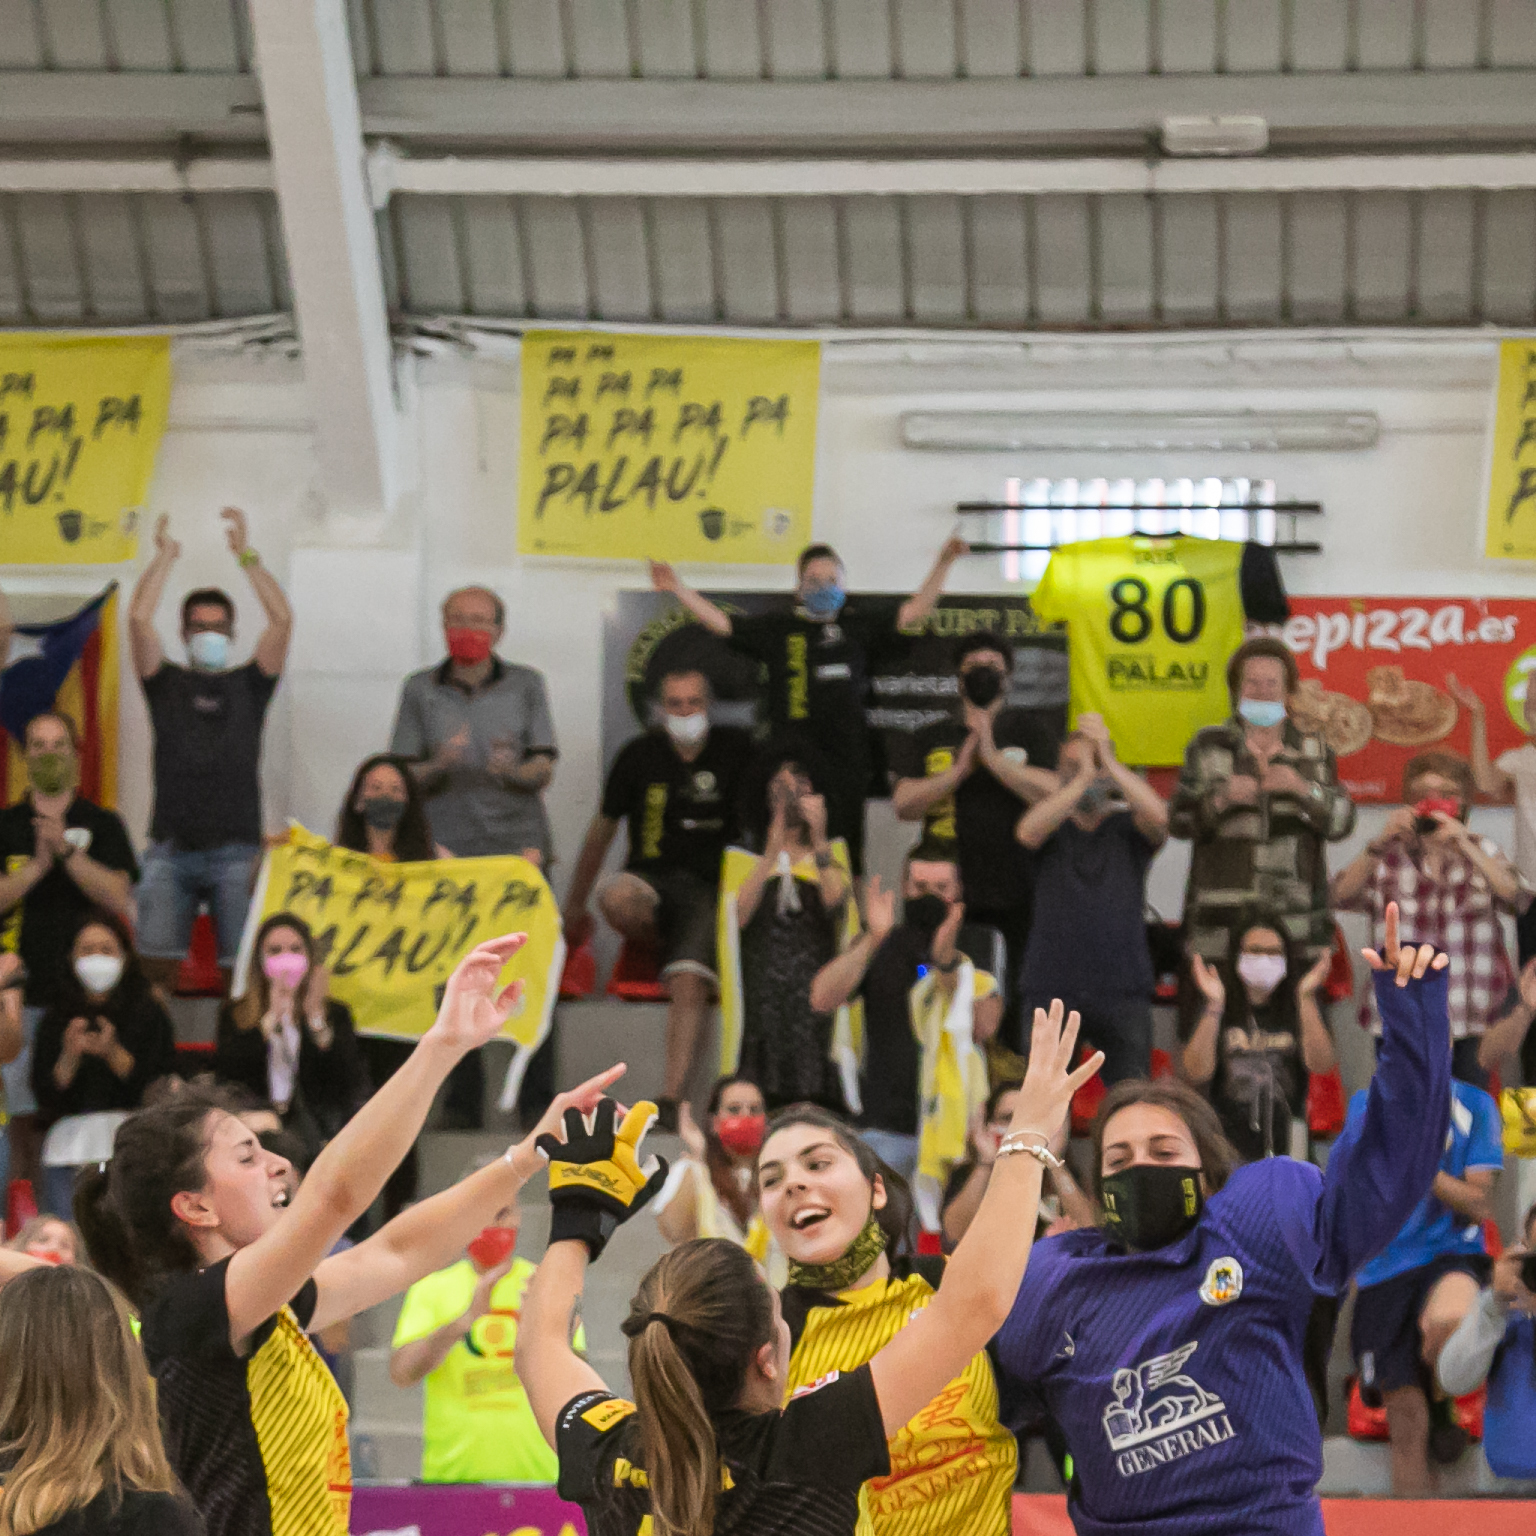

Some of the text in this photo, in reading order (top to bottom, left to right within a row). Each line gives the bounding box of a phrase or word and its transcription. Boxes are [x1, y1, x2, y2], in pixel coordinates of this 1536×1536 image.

[27, 402, 75, 450] PA
[93, 394, 142, 440] PA
[540, 393, 790, 456] PA PA PA PA
[533, 434, 729, 520] PALAU!
[1110, 578, 1206, 644] 80
[1281, 605, 1519, 670] epizza.es
[1108, 661, 1209, 681] PALAU
[1117, 1414, 1237, 1478] GENERALI
